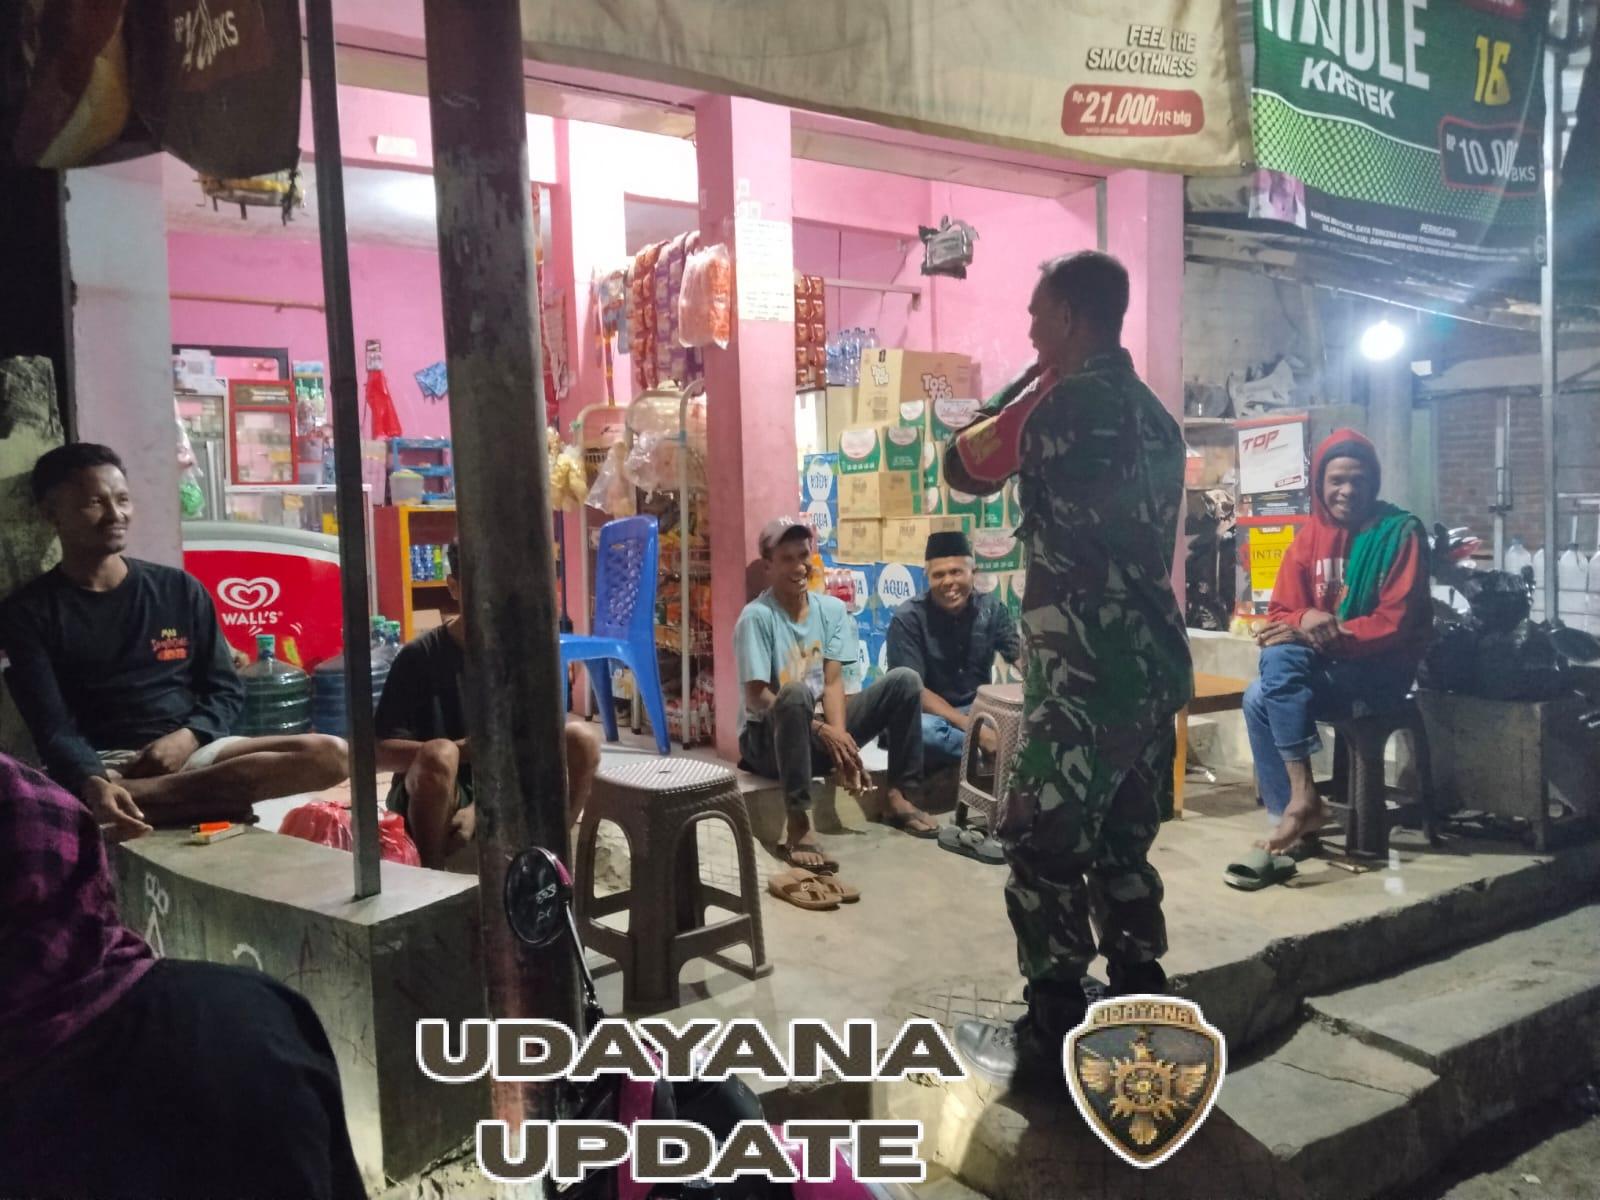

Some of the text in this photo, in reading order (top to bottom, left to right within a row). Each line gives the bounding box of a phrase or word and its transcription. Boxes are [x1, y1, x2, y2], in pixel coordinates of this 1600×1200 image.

[1127, 24, 1197, 53] FEEL THE
[1086, 48, 1197, 78] SMOOTHNESS
[1474, 35, 1512, 106] 16
[1301, 57, 1396, 118] KRETEK
[1242, 430, 1280, 451] TOP
[883, 579, 910, 599] AQUA
[221, 611, 279, 626] WALL'S
